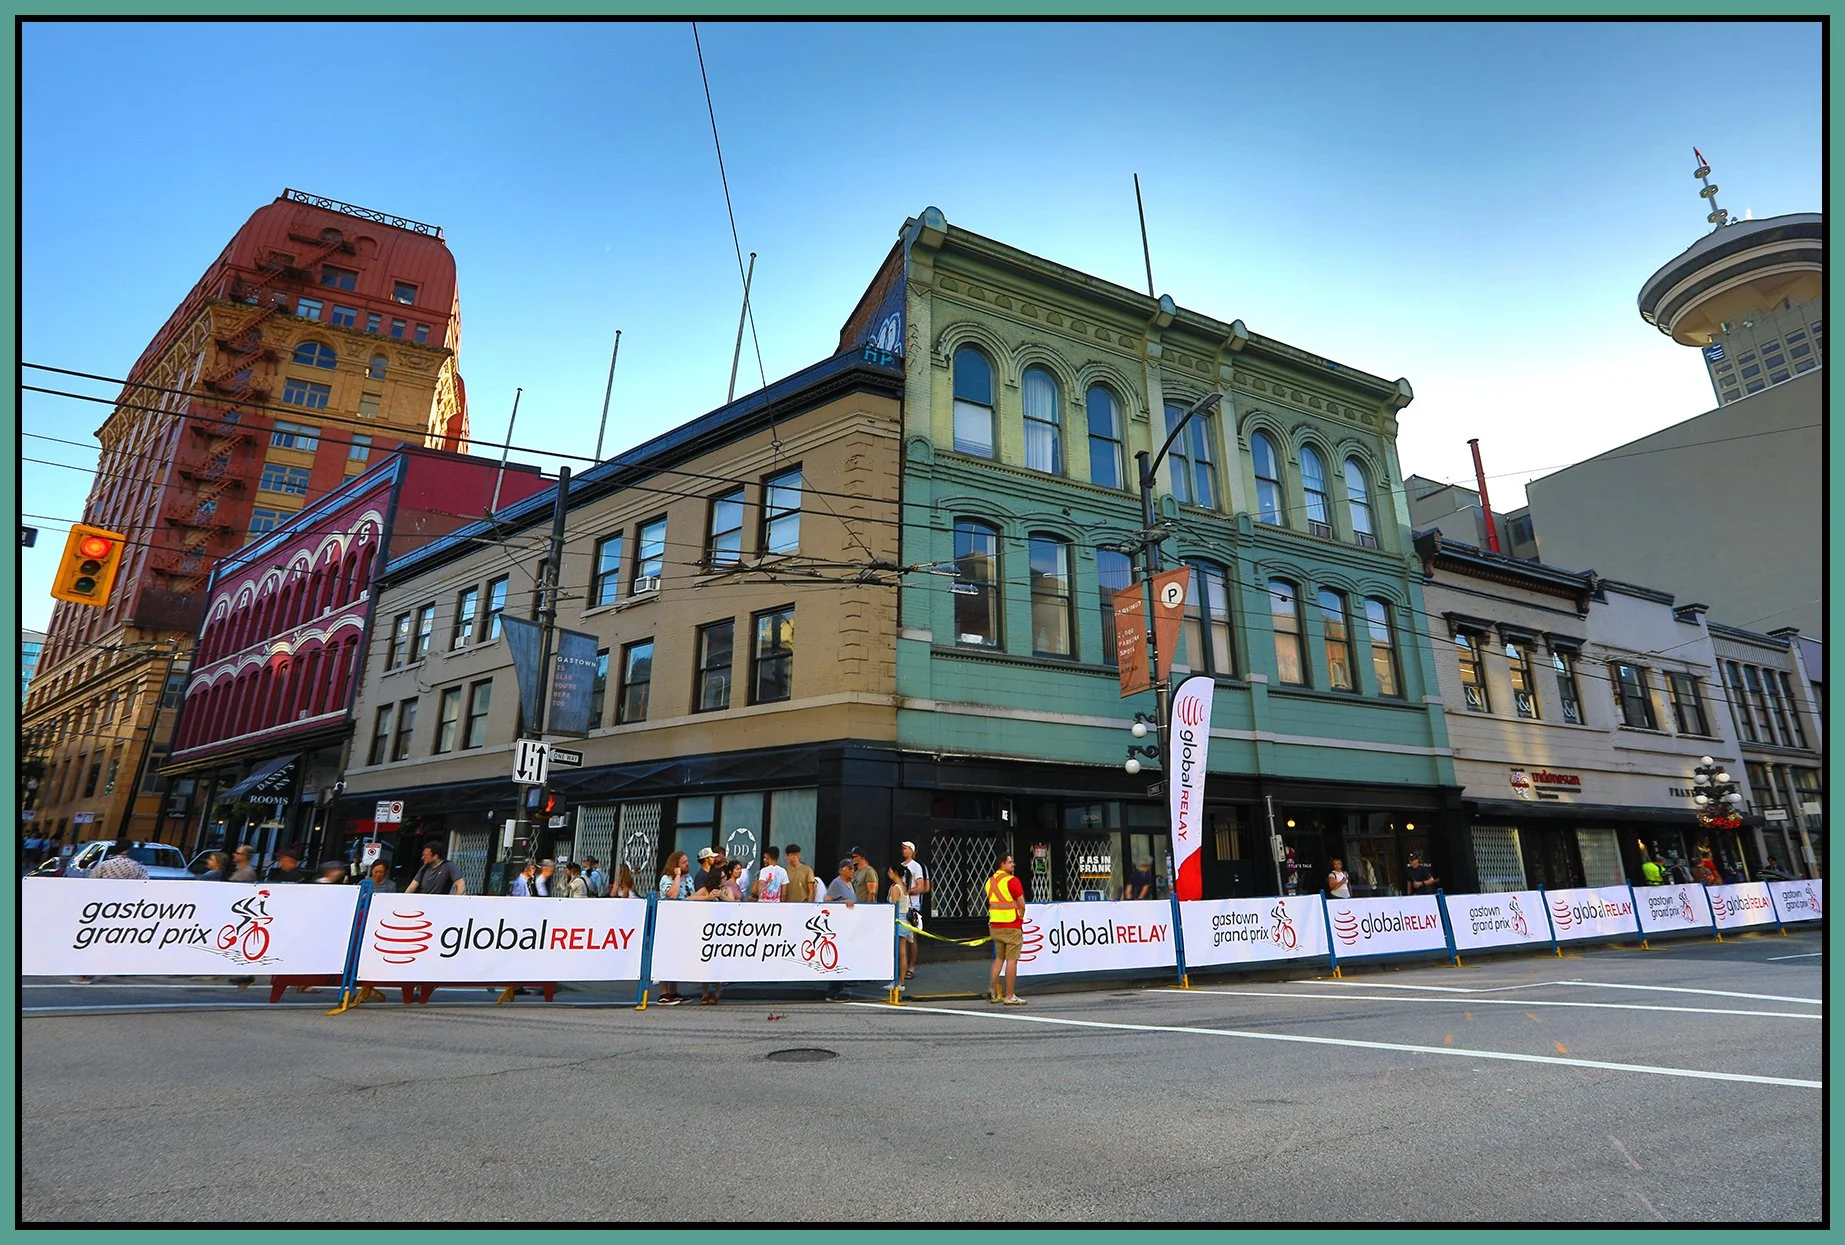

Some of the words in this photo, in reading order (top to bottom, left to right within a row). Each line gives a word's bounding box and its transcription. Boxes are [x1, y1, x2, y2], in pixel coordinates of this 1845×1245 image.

[1168, 588, 1178, 603] P
[557, 656, 597, 667] GASTOWN
[553, 752, 565, 760] ONE
[566, 754, 578, 762] WAY
[250, 795, 288, 805] ROOMS
[732, 845, 749, 856] DD
[1101, 856, 1111, 864] IN
[1080, 865, 1111, 873] FRANK
[78, 899, 195, 924] gastown
[1469, 905, 1500, 921] gastown
[1213, 912, 1258, 930] gastown
[1472, 920, 1493, 935] grand
[1494, 916, 1510, 932] prix
[72, 922, 158, 949] grand
[157, 924, 210, 949] prix
[701, 920, 780, 941] gastown
[1213, 929, 1248, 947] grand
[1249, 927, 1269, 944] prix
[700, 939, 757, 962] grand
[761, 940, 796, 961] prix
